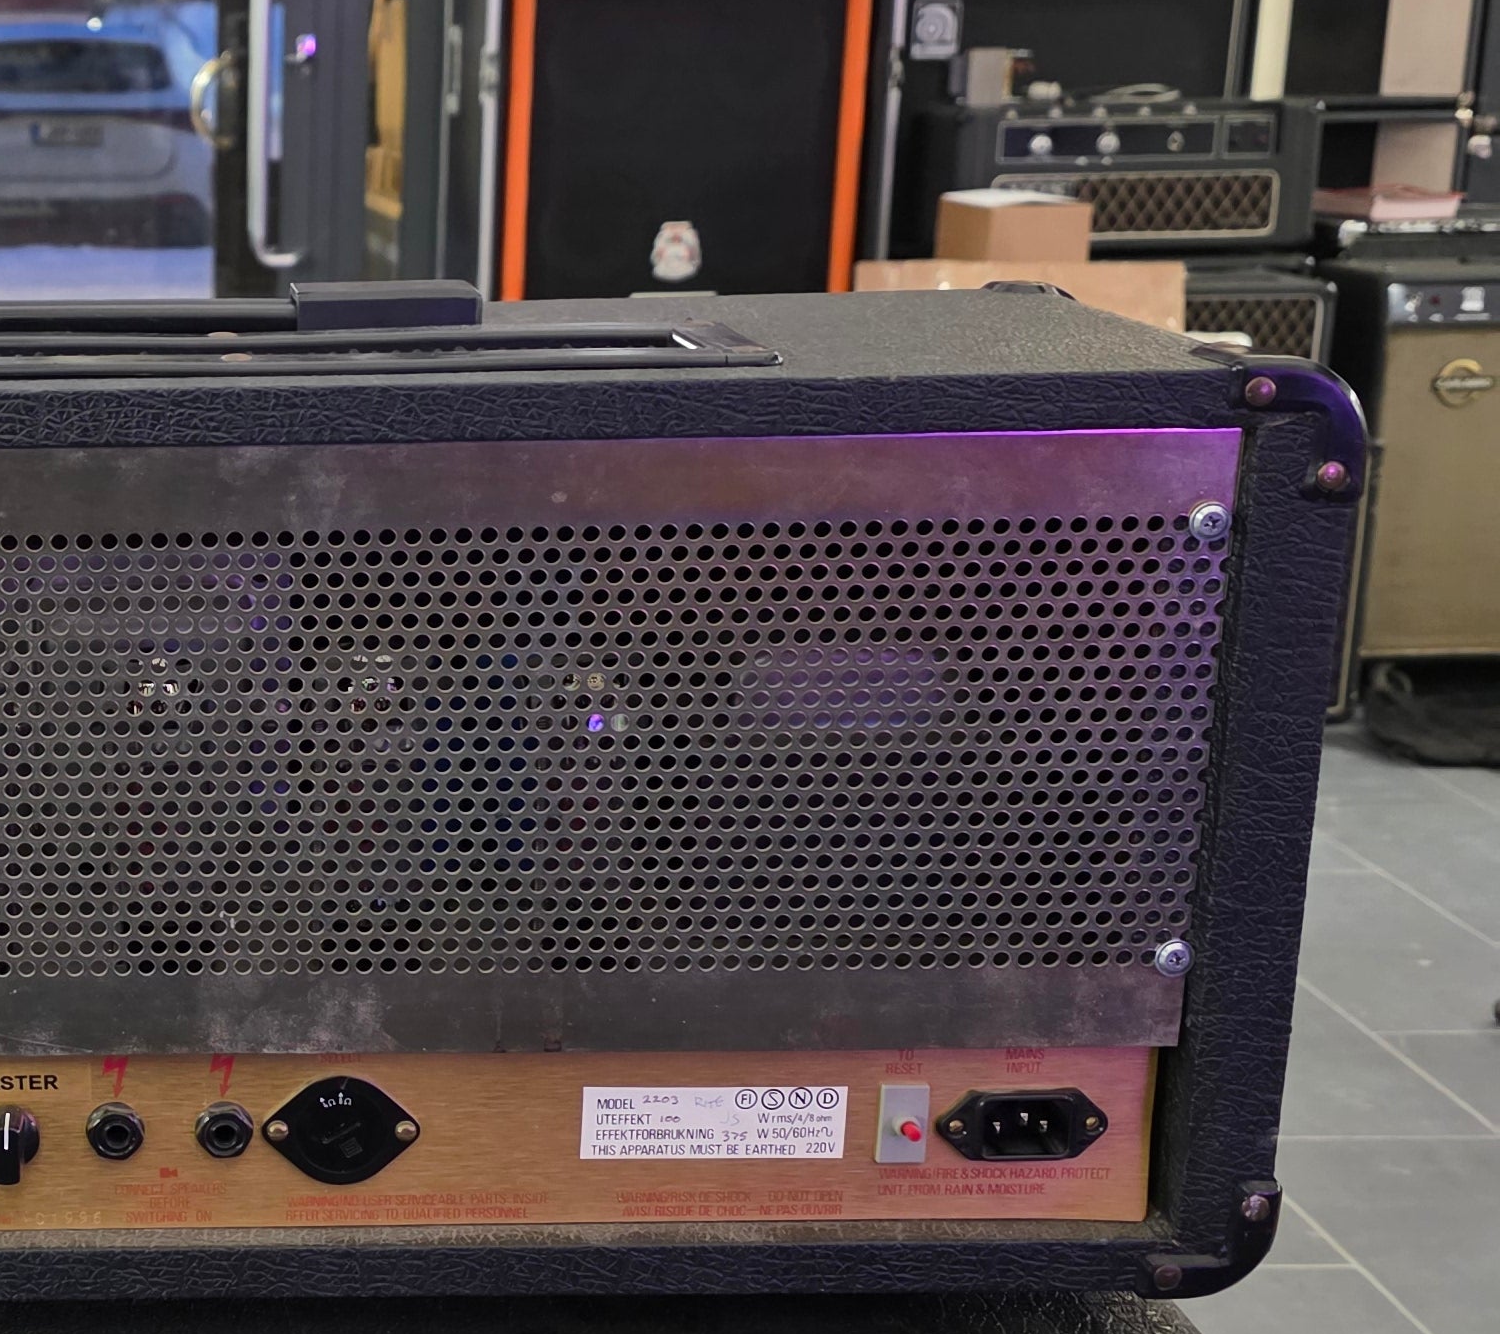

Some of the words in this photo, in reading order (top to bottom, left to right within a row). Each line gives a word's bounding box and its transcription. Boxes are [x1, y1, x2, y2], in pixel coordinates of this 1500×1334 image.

[1005, 1048, 1045, 1060] MAINS
[885, 1063, 923, 1075] RESET
[1006, 1062, 1041, 1073] INPUT
[597, 1098, 636, 1110] MODEL
[642, 1094, 679, 1105] 2203
[596, 1113, 653, 1125] UTEFFEKT
[660, 1115, 681, 1123] 100
[595, 1129, 715, 1140] EFFEKTFORBRUKNING
[722, 1130, 749, 1142] 375
[591, 1144, 617, 1156] THIS
[619, 1144, 686, 1156] APPARATUS
[689, 1144, 722, 1155] MUST
[726, 1144, 740, 1155] BE
[745, 1144, 796, 1155] EARTHED
[805, 1142, 836, 1154] 220V
[970, 1167, 1007, 1179] SHOCK
[1060, 1168, 1111, 1179] PROTECT
[877, 1184, 904, 1195] UNIT
[908, 1184, 940, 1195] FROM
[944, 1183, 973, 1195] RAIN
[987, 1183, 1046, 1195] MOISTURE
[149, 1196, 191, 1208] BEFORE
[363, 1194, 392, 1206] USER
[470, 1193, 507, 1205] PARTS
[285, 1209, 319, 1221] REFER
[385, 1209, 399, 1220] TO
[403, 1208, 460, 1219] QUALIFIED
[465, 1207, 529, 1219] PERSONNEL
[716, 1204, 748, 1216] CHOC
[777, 1204, 798, 1215] PAS
[125, 1210, 188, 1223] SWITCHING
[196, 1210, 213, 1222] ON
